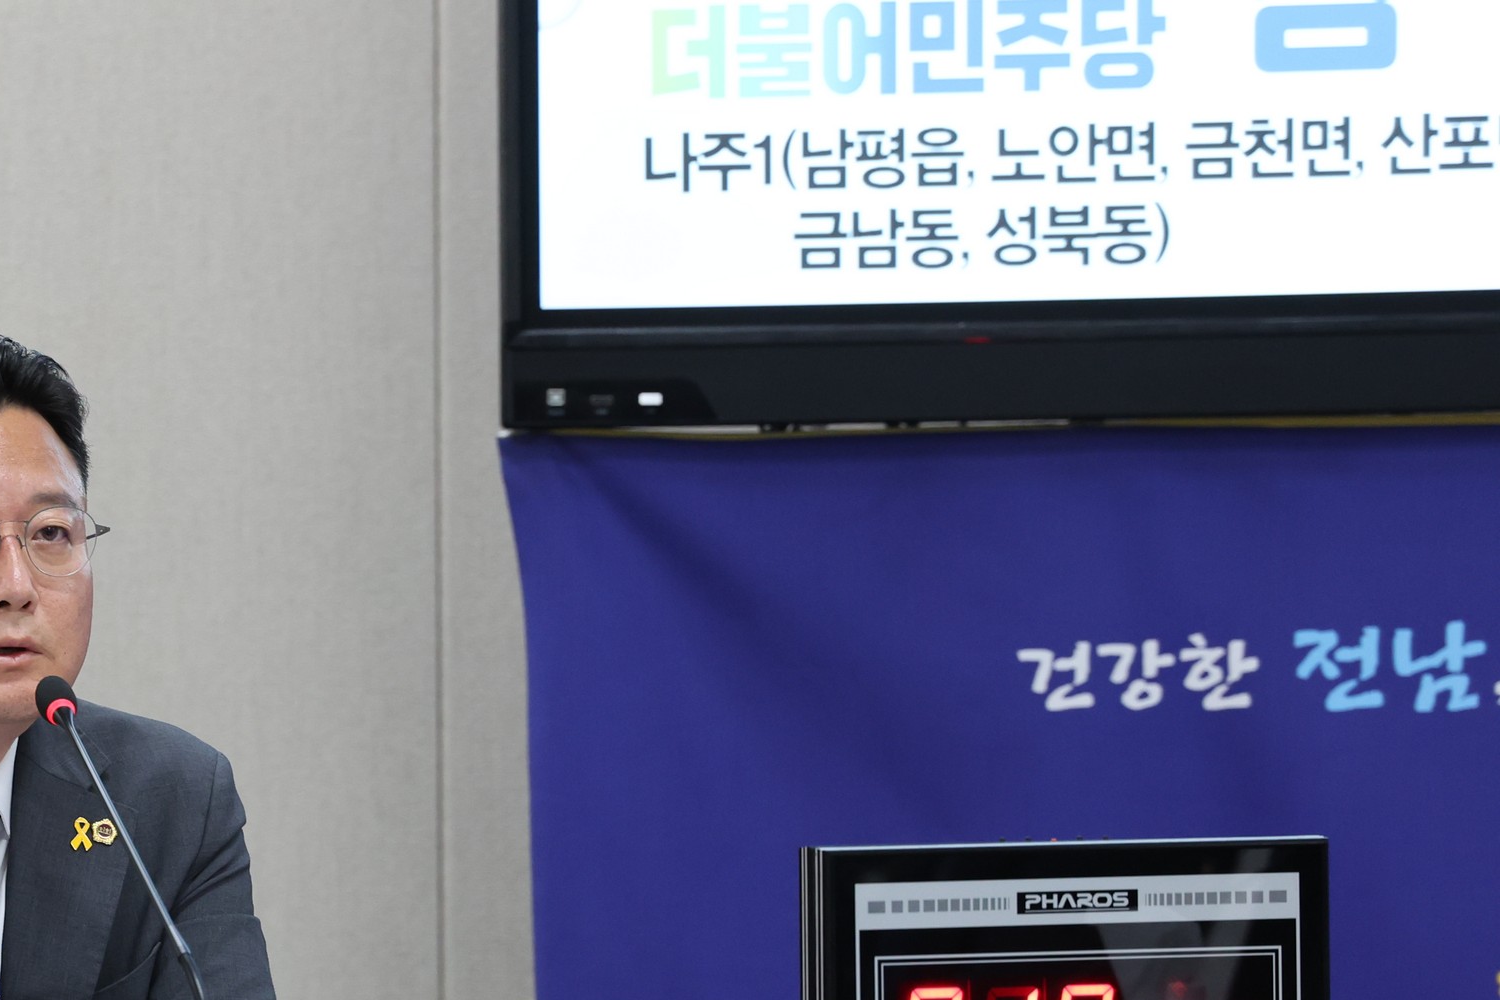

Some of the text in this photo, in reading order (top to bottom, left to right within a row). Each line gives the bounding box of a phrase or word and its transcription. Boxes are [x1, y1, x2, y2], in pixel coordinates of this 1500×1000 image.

[651, 0, 1167, 98] 더불어민주당
[645, 127, 975, 192] 나주1(남평읍,
[991, 121, 1169, 183] 노안면,
[1185, 116, 1364, 179] 금천면,
[794, 202, 1170, 269] 금남동, 성북동)
[1016, 619, 1488, 713] 건강한 전남
[1024, 891, 1130, 910] PHAROS
